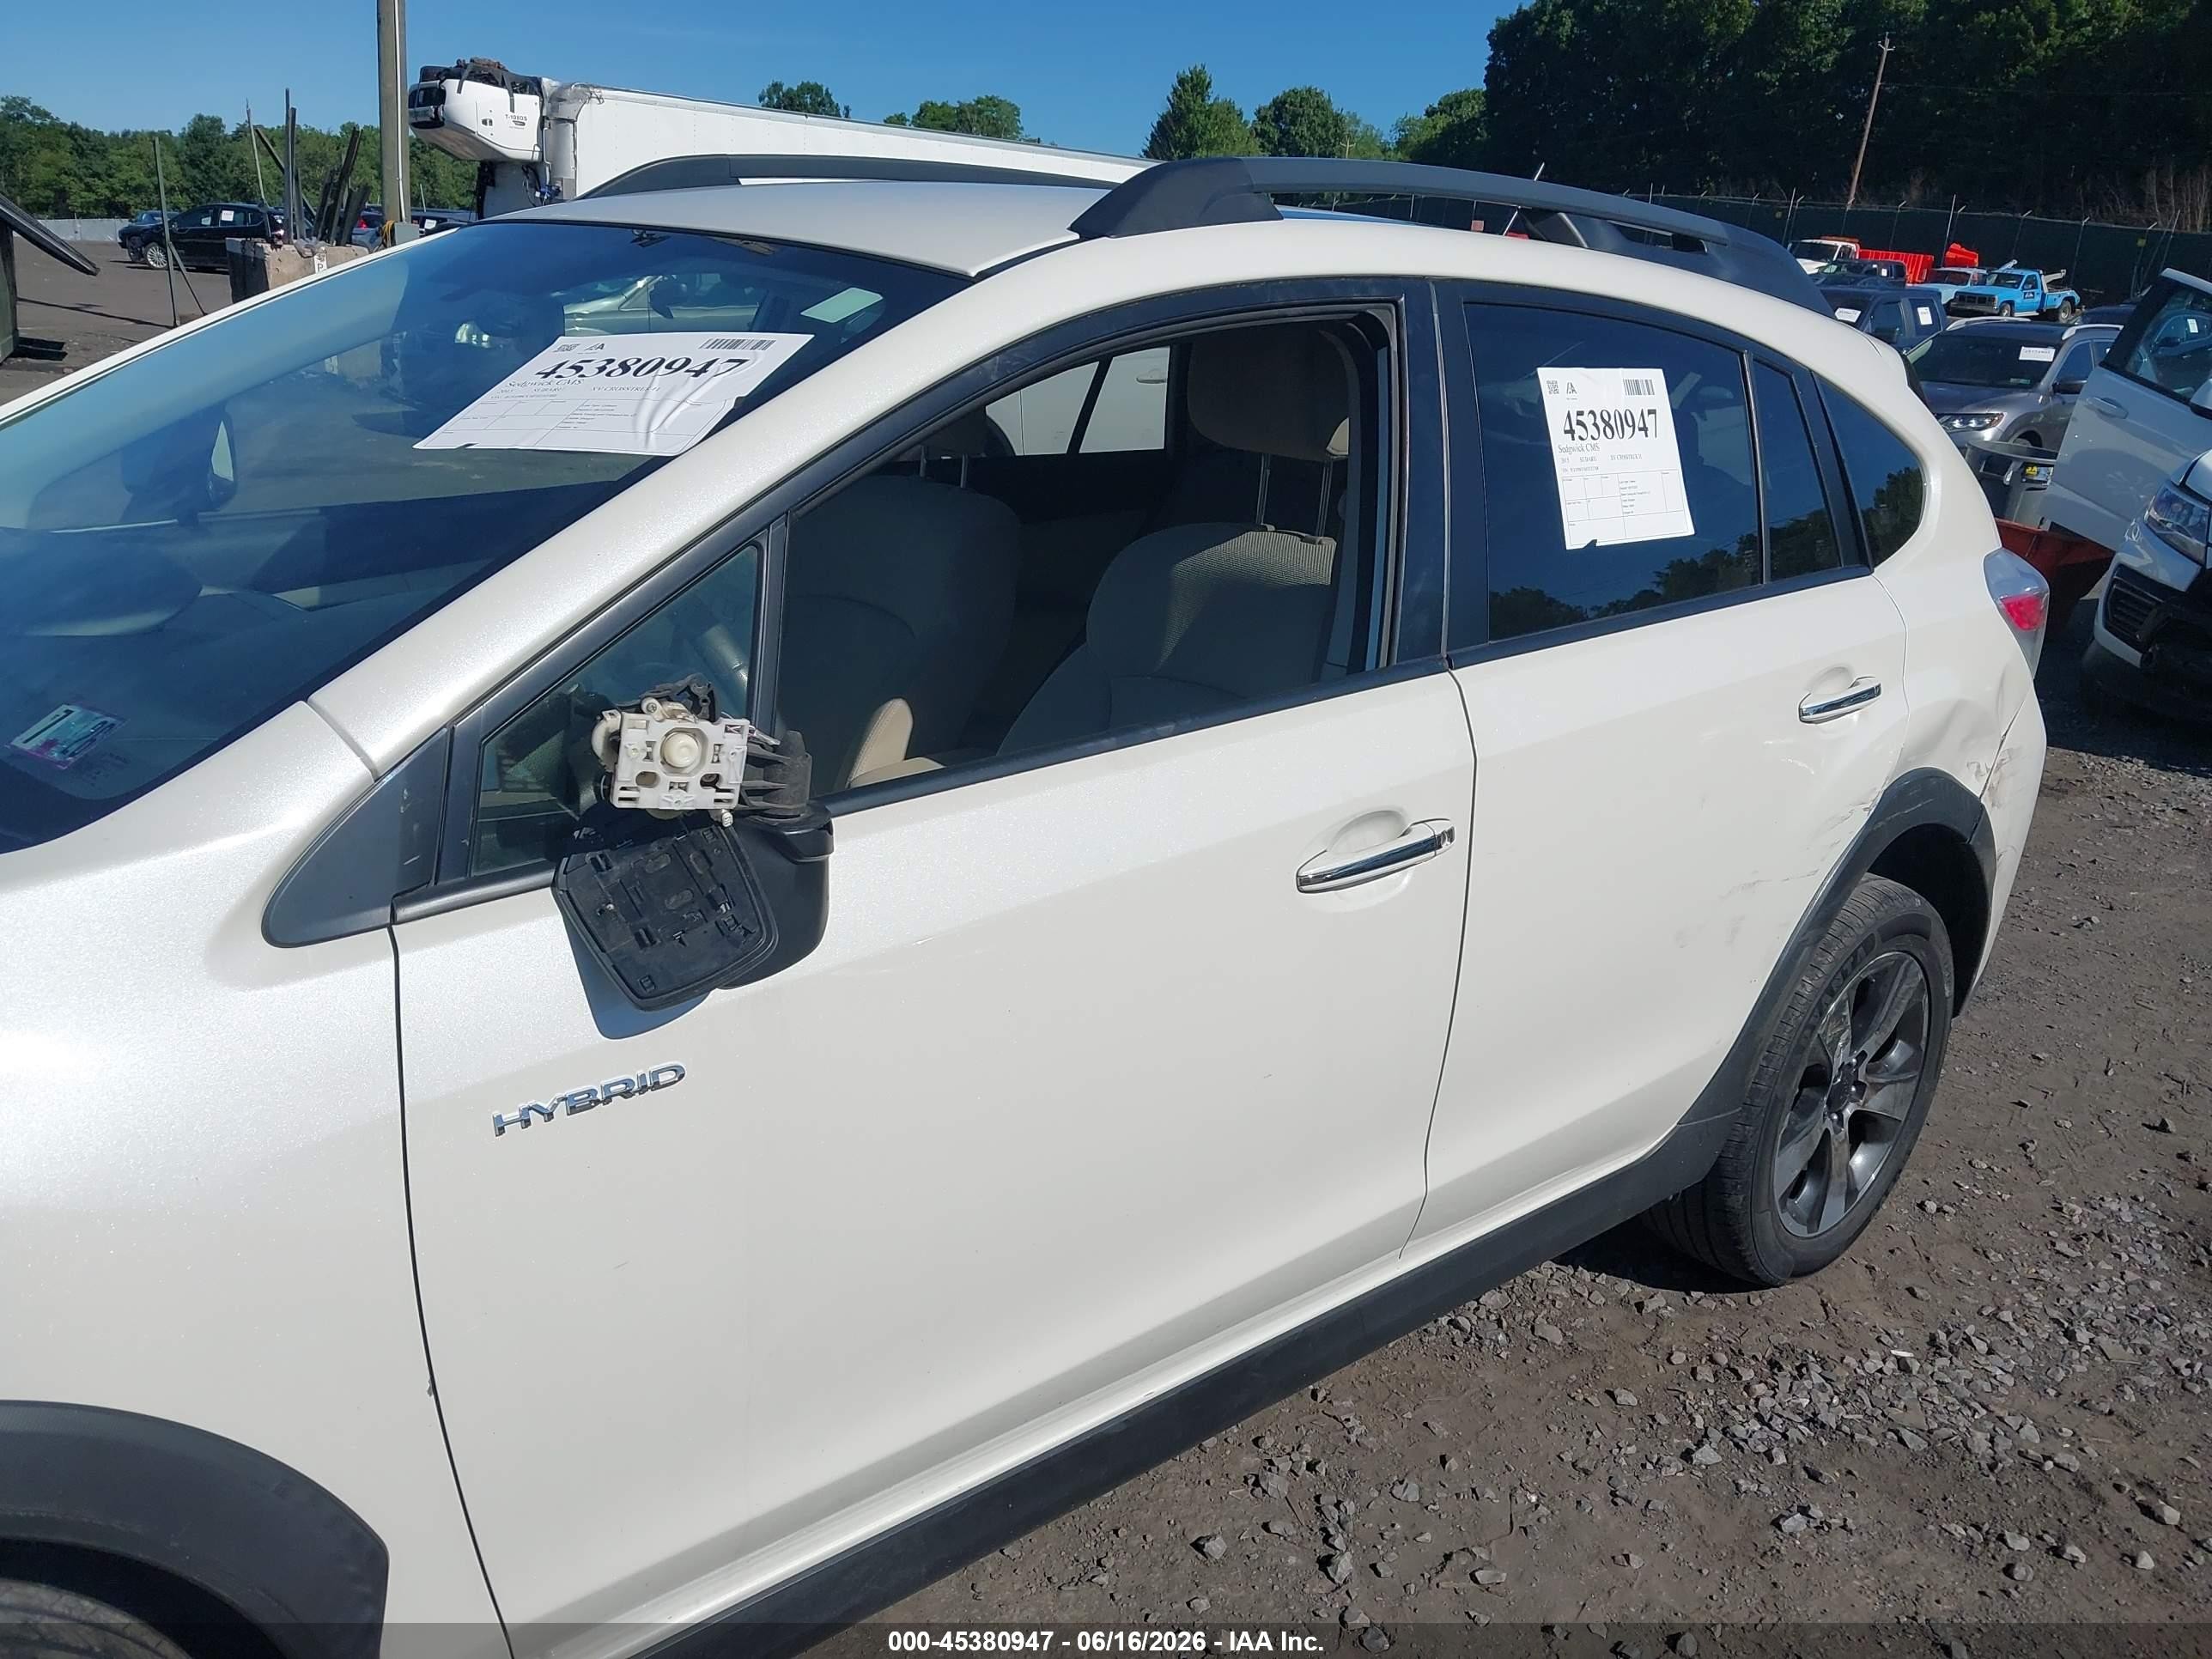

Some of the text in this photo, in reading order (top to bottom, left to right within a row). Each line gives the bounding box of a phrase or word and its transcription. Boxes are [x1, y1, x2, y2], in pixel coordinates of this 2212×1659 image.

[534, 356, 750, 379] 45380947
[1563, 408, 1657, 441] 45380947
[1558, 442, 1601, 455] Sedgwick CMS
[491, 1060, 688, 1138] HYBRID
